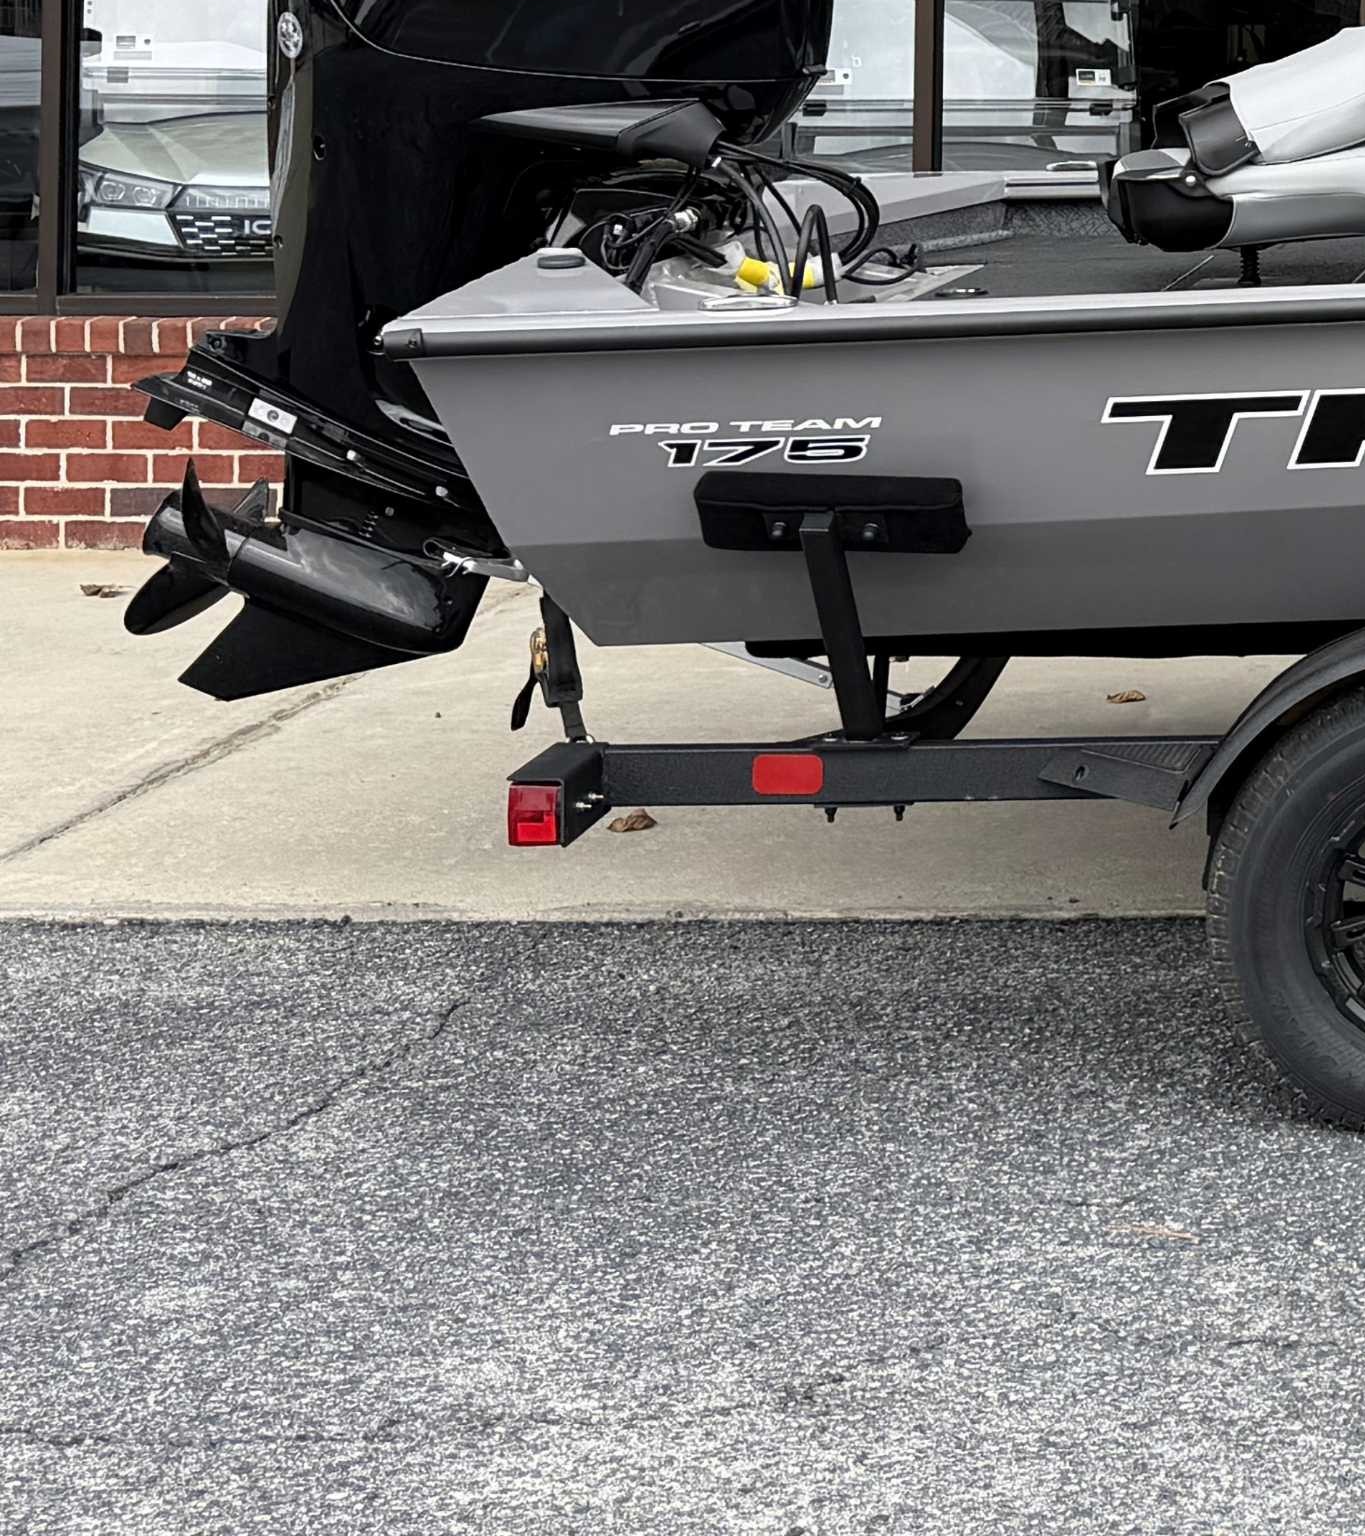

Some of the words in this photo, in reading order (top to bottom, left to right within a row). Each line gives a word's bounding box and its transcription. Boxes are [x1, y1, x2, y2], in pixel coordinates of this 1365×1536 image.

[608, 420, 720, 437] PRO
[728, 415, 883, 434] TEAM
[657, 433, 871, 468] 175
